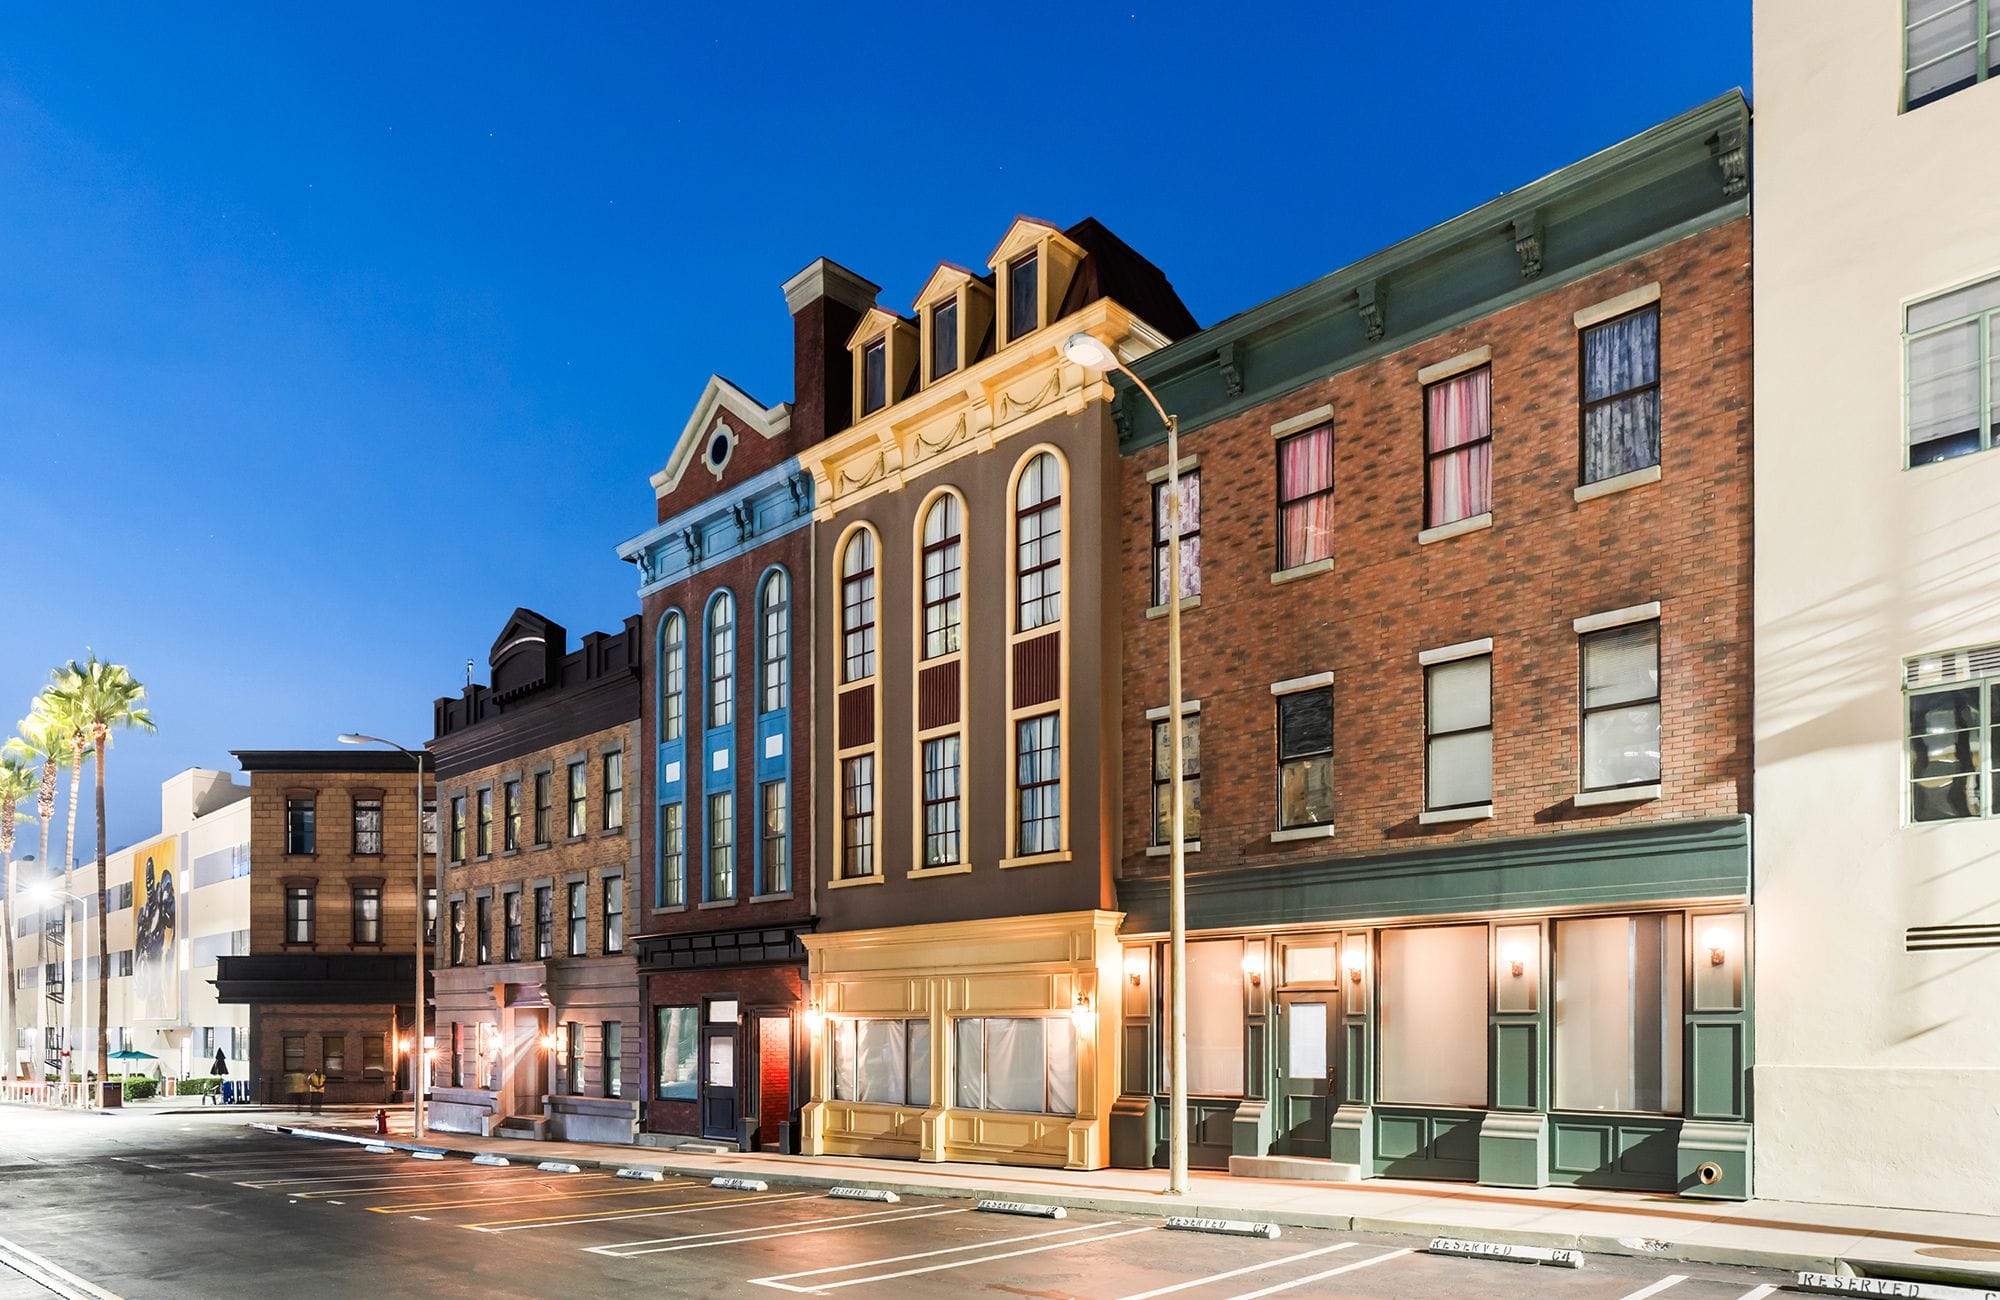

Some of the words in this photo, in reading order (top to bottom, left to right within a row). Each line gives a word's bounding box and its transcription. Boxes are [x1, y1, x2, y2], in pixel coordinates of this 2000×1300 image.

[981, 1200, 1026, 1212] RESERVED
[1167, 1216, 1227, 1230] RESERVED
[1431, 1238, 1513, 1257] RESERVED
[1551, 1250, 1571, 1263] C4
[1802, 1273, 1920, 1299] RESERVED
